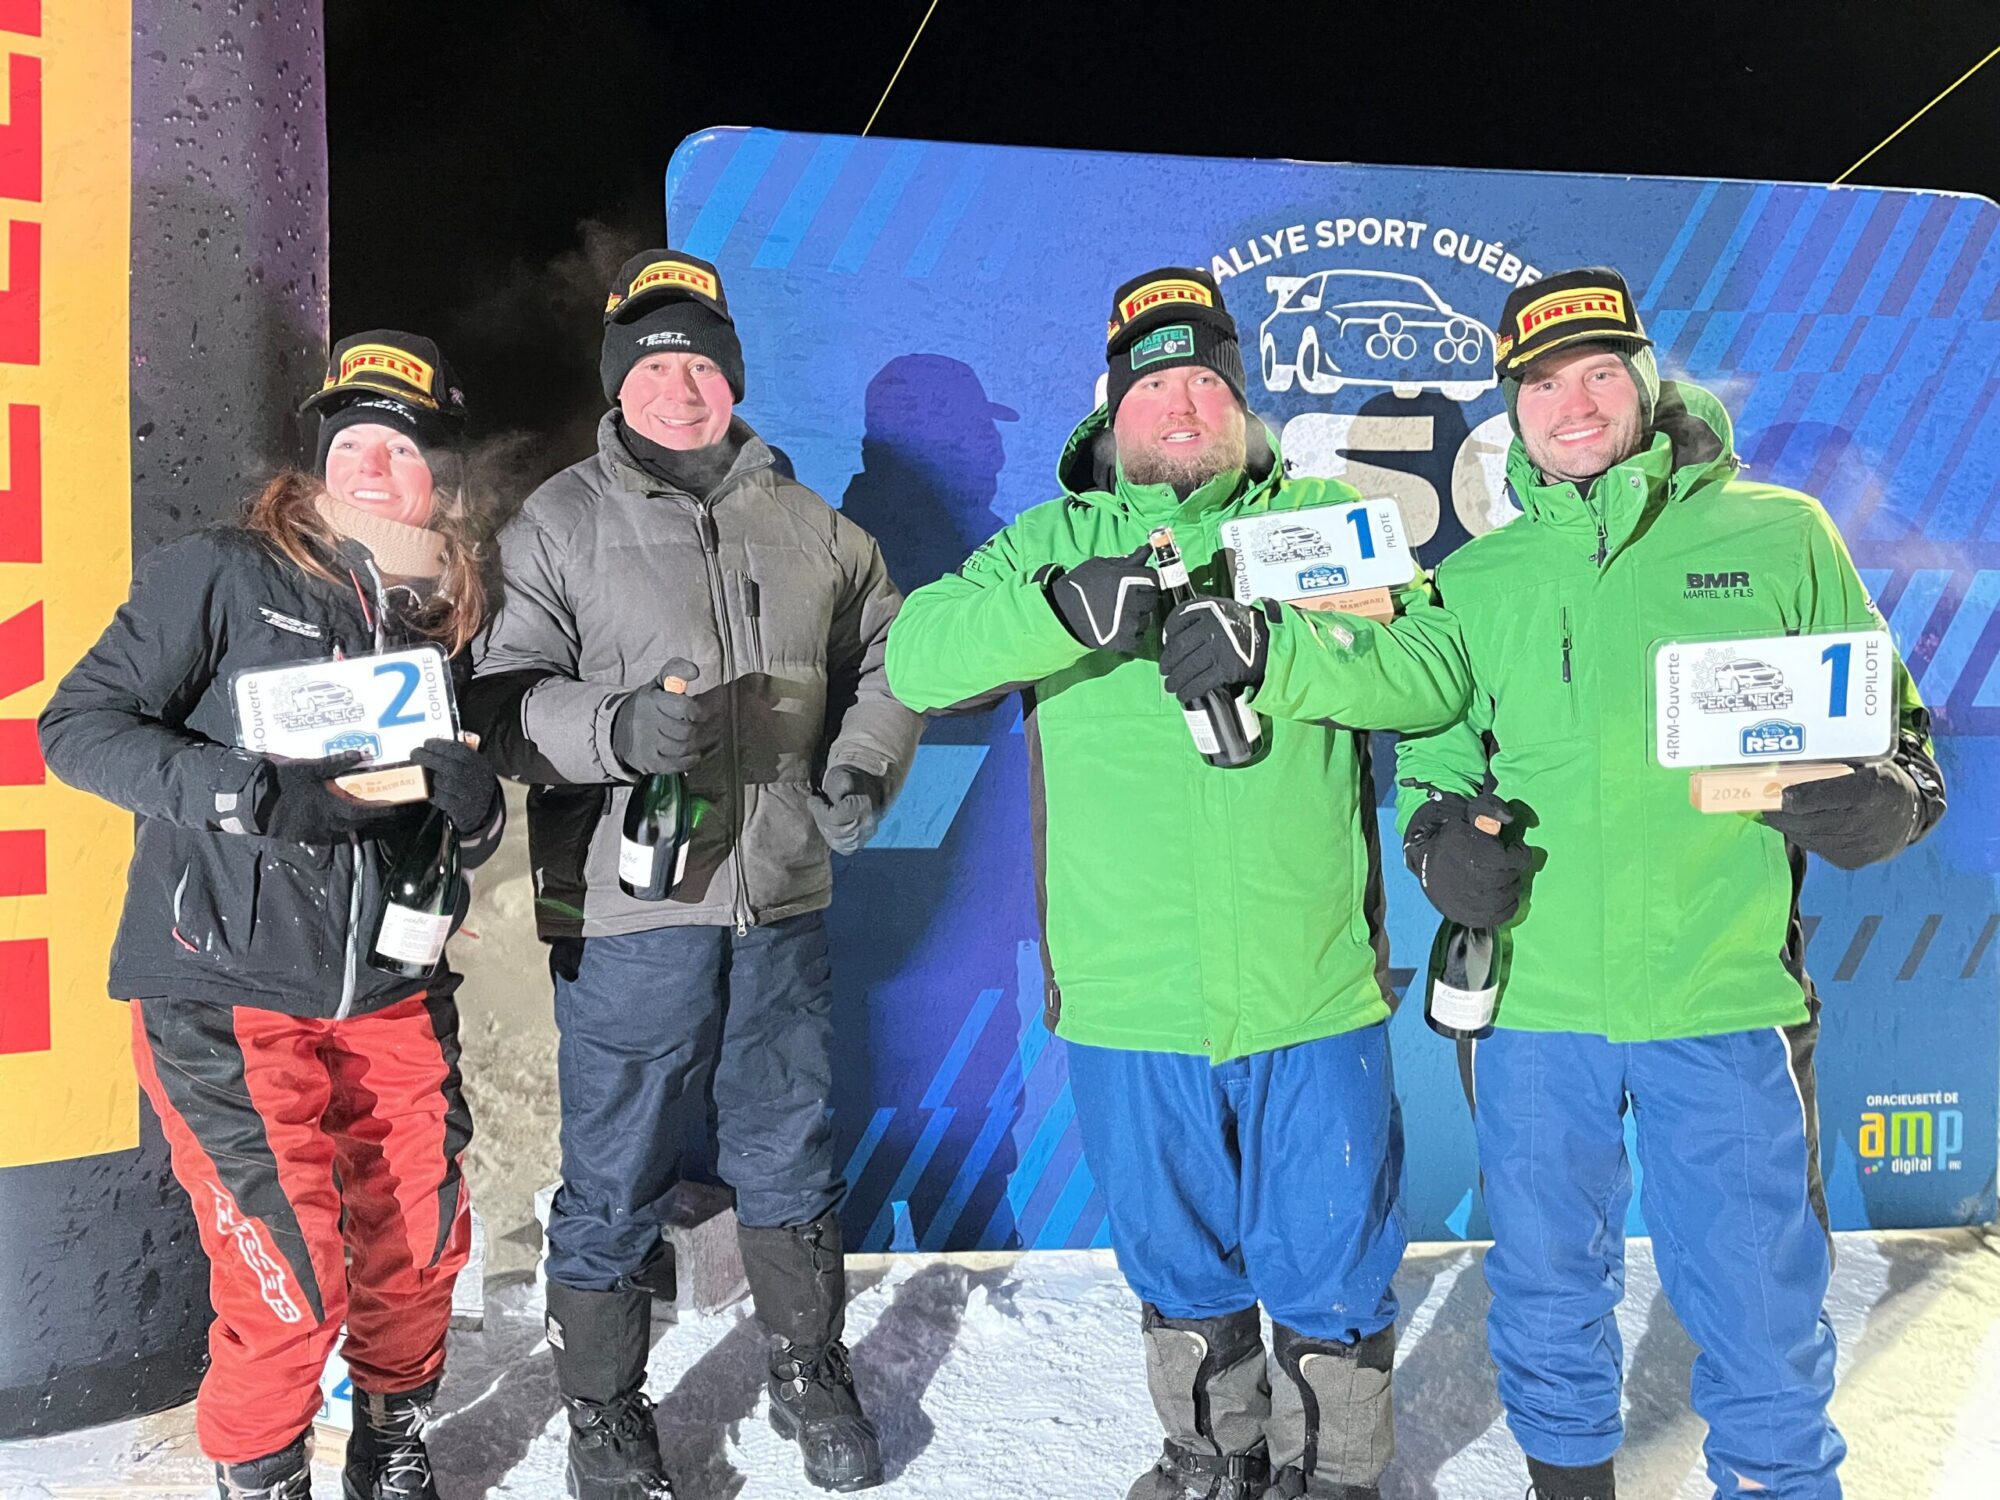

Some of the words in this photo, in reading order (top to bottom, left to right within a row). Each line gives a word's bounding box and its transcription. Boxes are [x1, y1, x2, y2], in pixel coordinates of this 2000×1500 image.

[1210, 225, 1309, 285] ALLYE
[1315, 217, 1427, 250] SPORT
[1432, 228, 1543, 289] QUÉBE
[632, 265, 709, 292] PIRELLI
[1125, 284, 1207, 320] PIRELLI
[1522, 293, 1618, 334] PIRELLI
[1134, 330, 1188, 352] MARTEL
[341, 349, 424, 383] PIRELLI
[1346, 507, 1375, 560] 1
[1379, 511, 1397, 548] PILOTE
[1230, 525, 1252, 600] 4RM-Ouverte
[1686, 571, 1750, 589] BMR
[1683, 589, 1721, 599] MARTEL
[1723, 589, 1730, 599] &
[373, 661, 426, 729] 2
[422, 656, 442, 721] COPILOTE
[1821, 642, 1852, 719] 1
[1865, 640, 1878, 716] COPILOTE
[248, 681, 267, 753] M-Ouverte
[1666, 653, 1680, 760] 4RM-Ouverte
[1699, 694, 1746, 710] PERCE
[1748, 691, 1793, 705] NEIGE
[1712, 788, 1751, 800] 2026
[1944, 1092, 1959, 1104] DE
[1859, 1110, 1963, 1171] amp
[1891, 1157, 1932, 1175] digital
